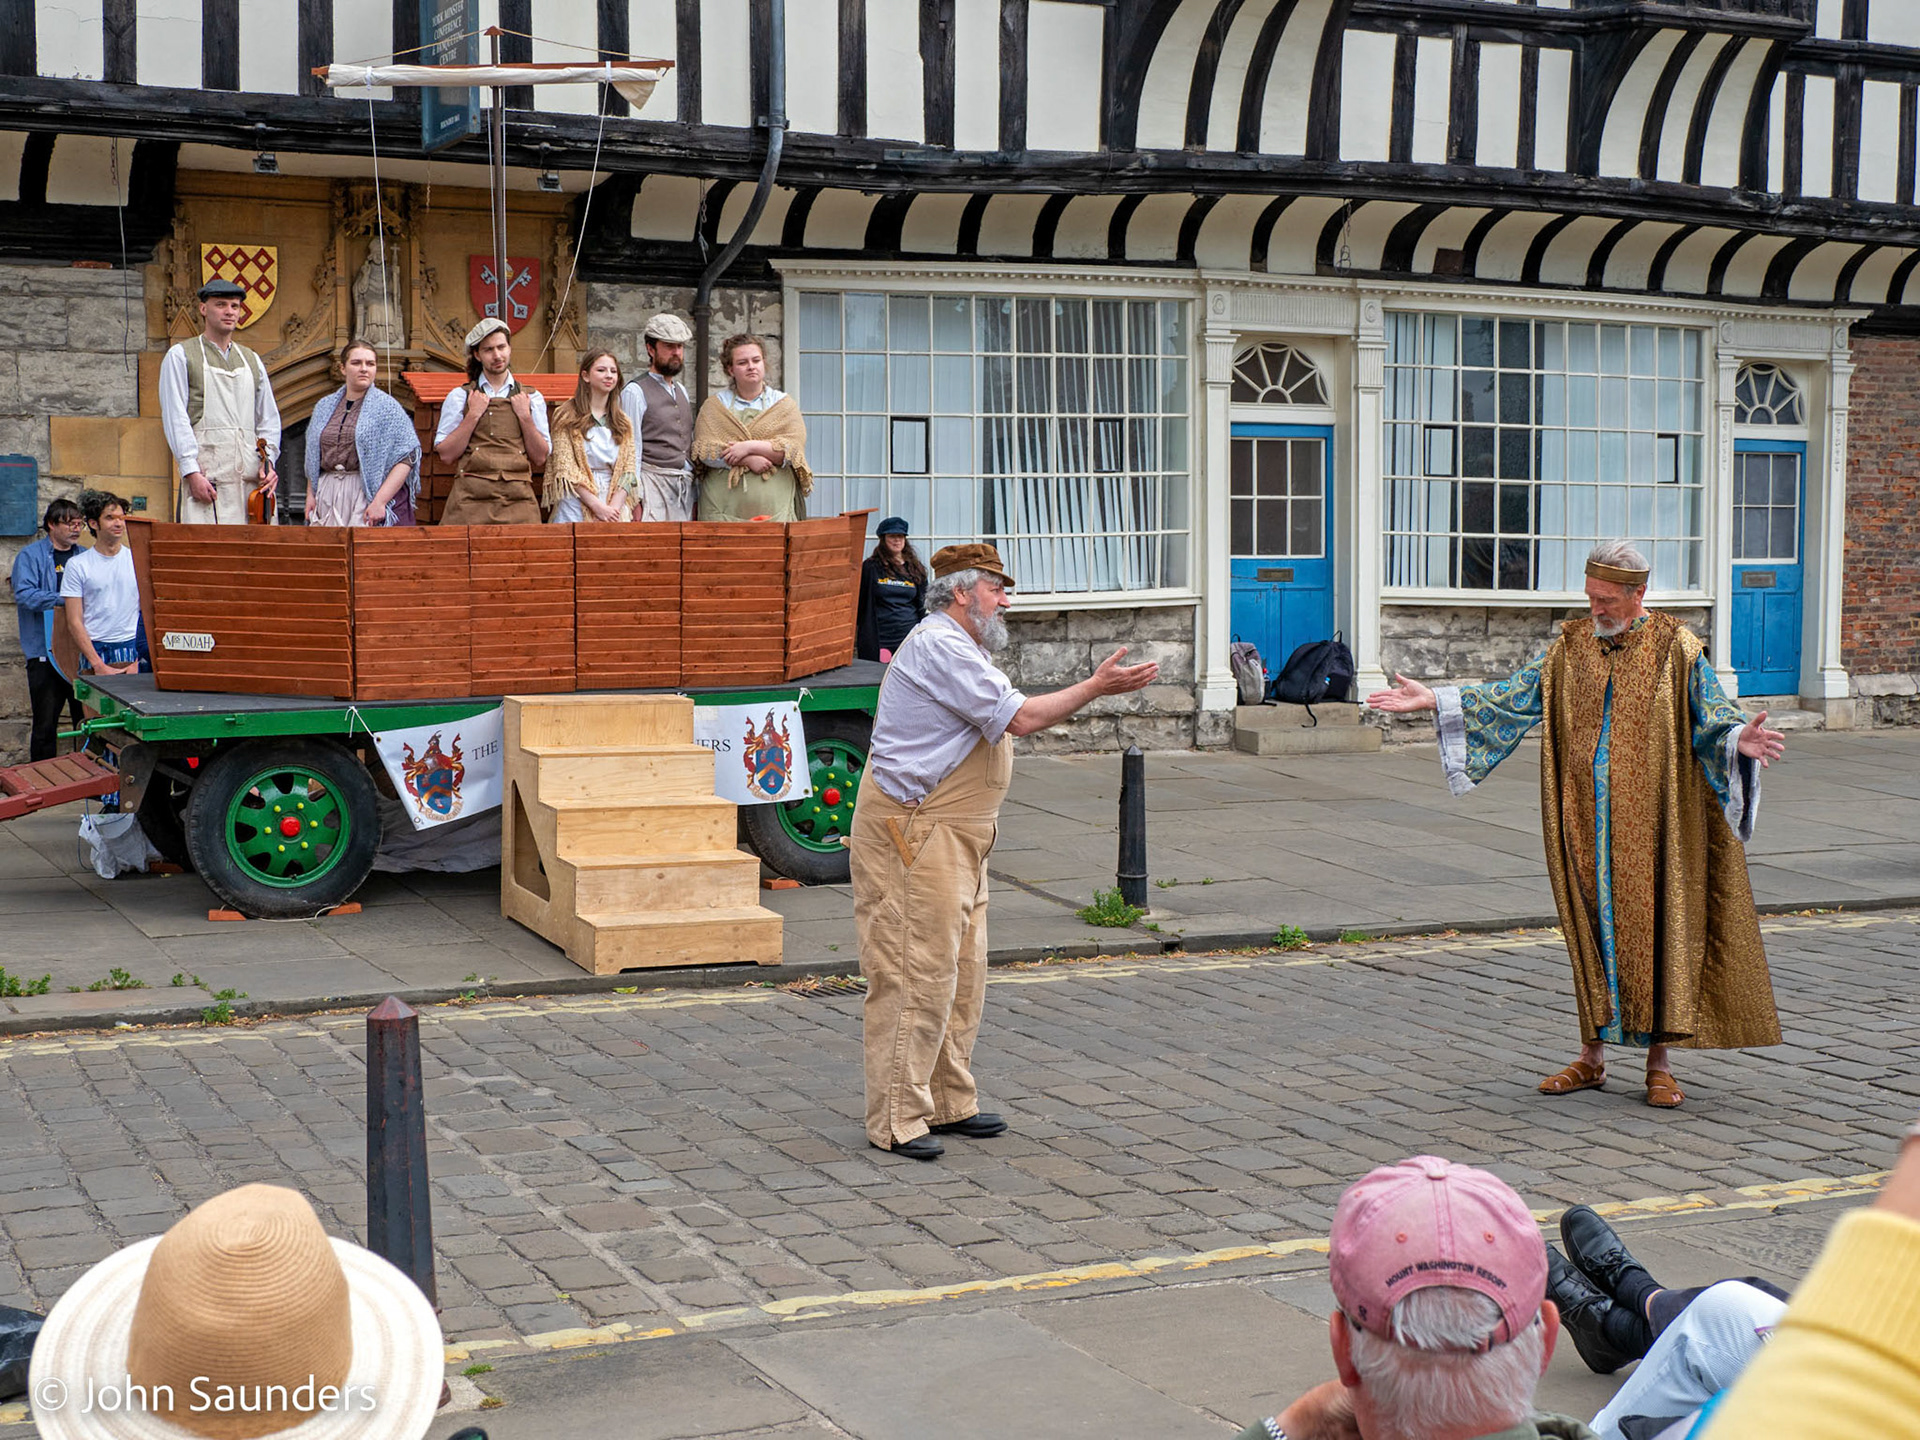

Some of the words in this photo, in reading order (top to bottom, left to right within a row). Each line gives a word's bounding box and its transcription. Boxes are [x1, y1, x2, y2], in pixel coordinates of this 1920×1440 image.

[443, 1, 464, 21] MINSTER
[433, 15, 462, 40] CONFERENCE
[439, 48, 457, 65] CENTRE
[183, 635, 211, 649] NOAH
[472, 740, 499, 760] THE
[1385, 1265, 1414, 1288] MOUNT
[1416, 1260, 1474, 1272] WASHINGTON
[1476, 1266, 1507, 1289] RESORT
